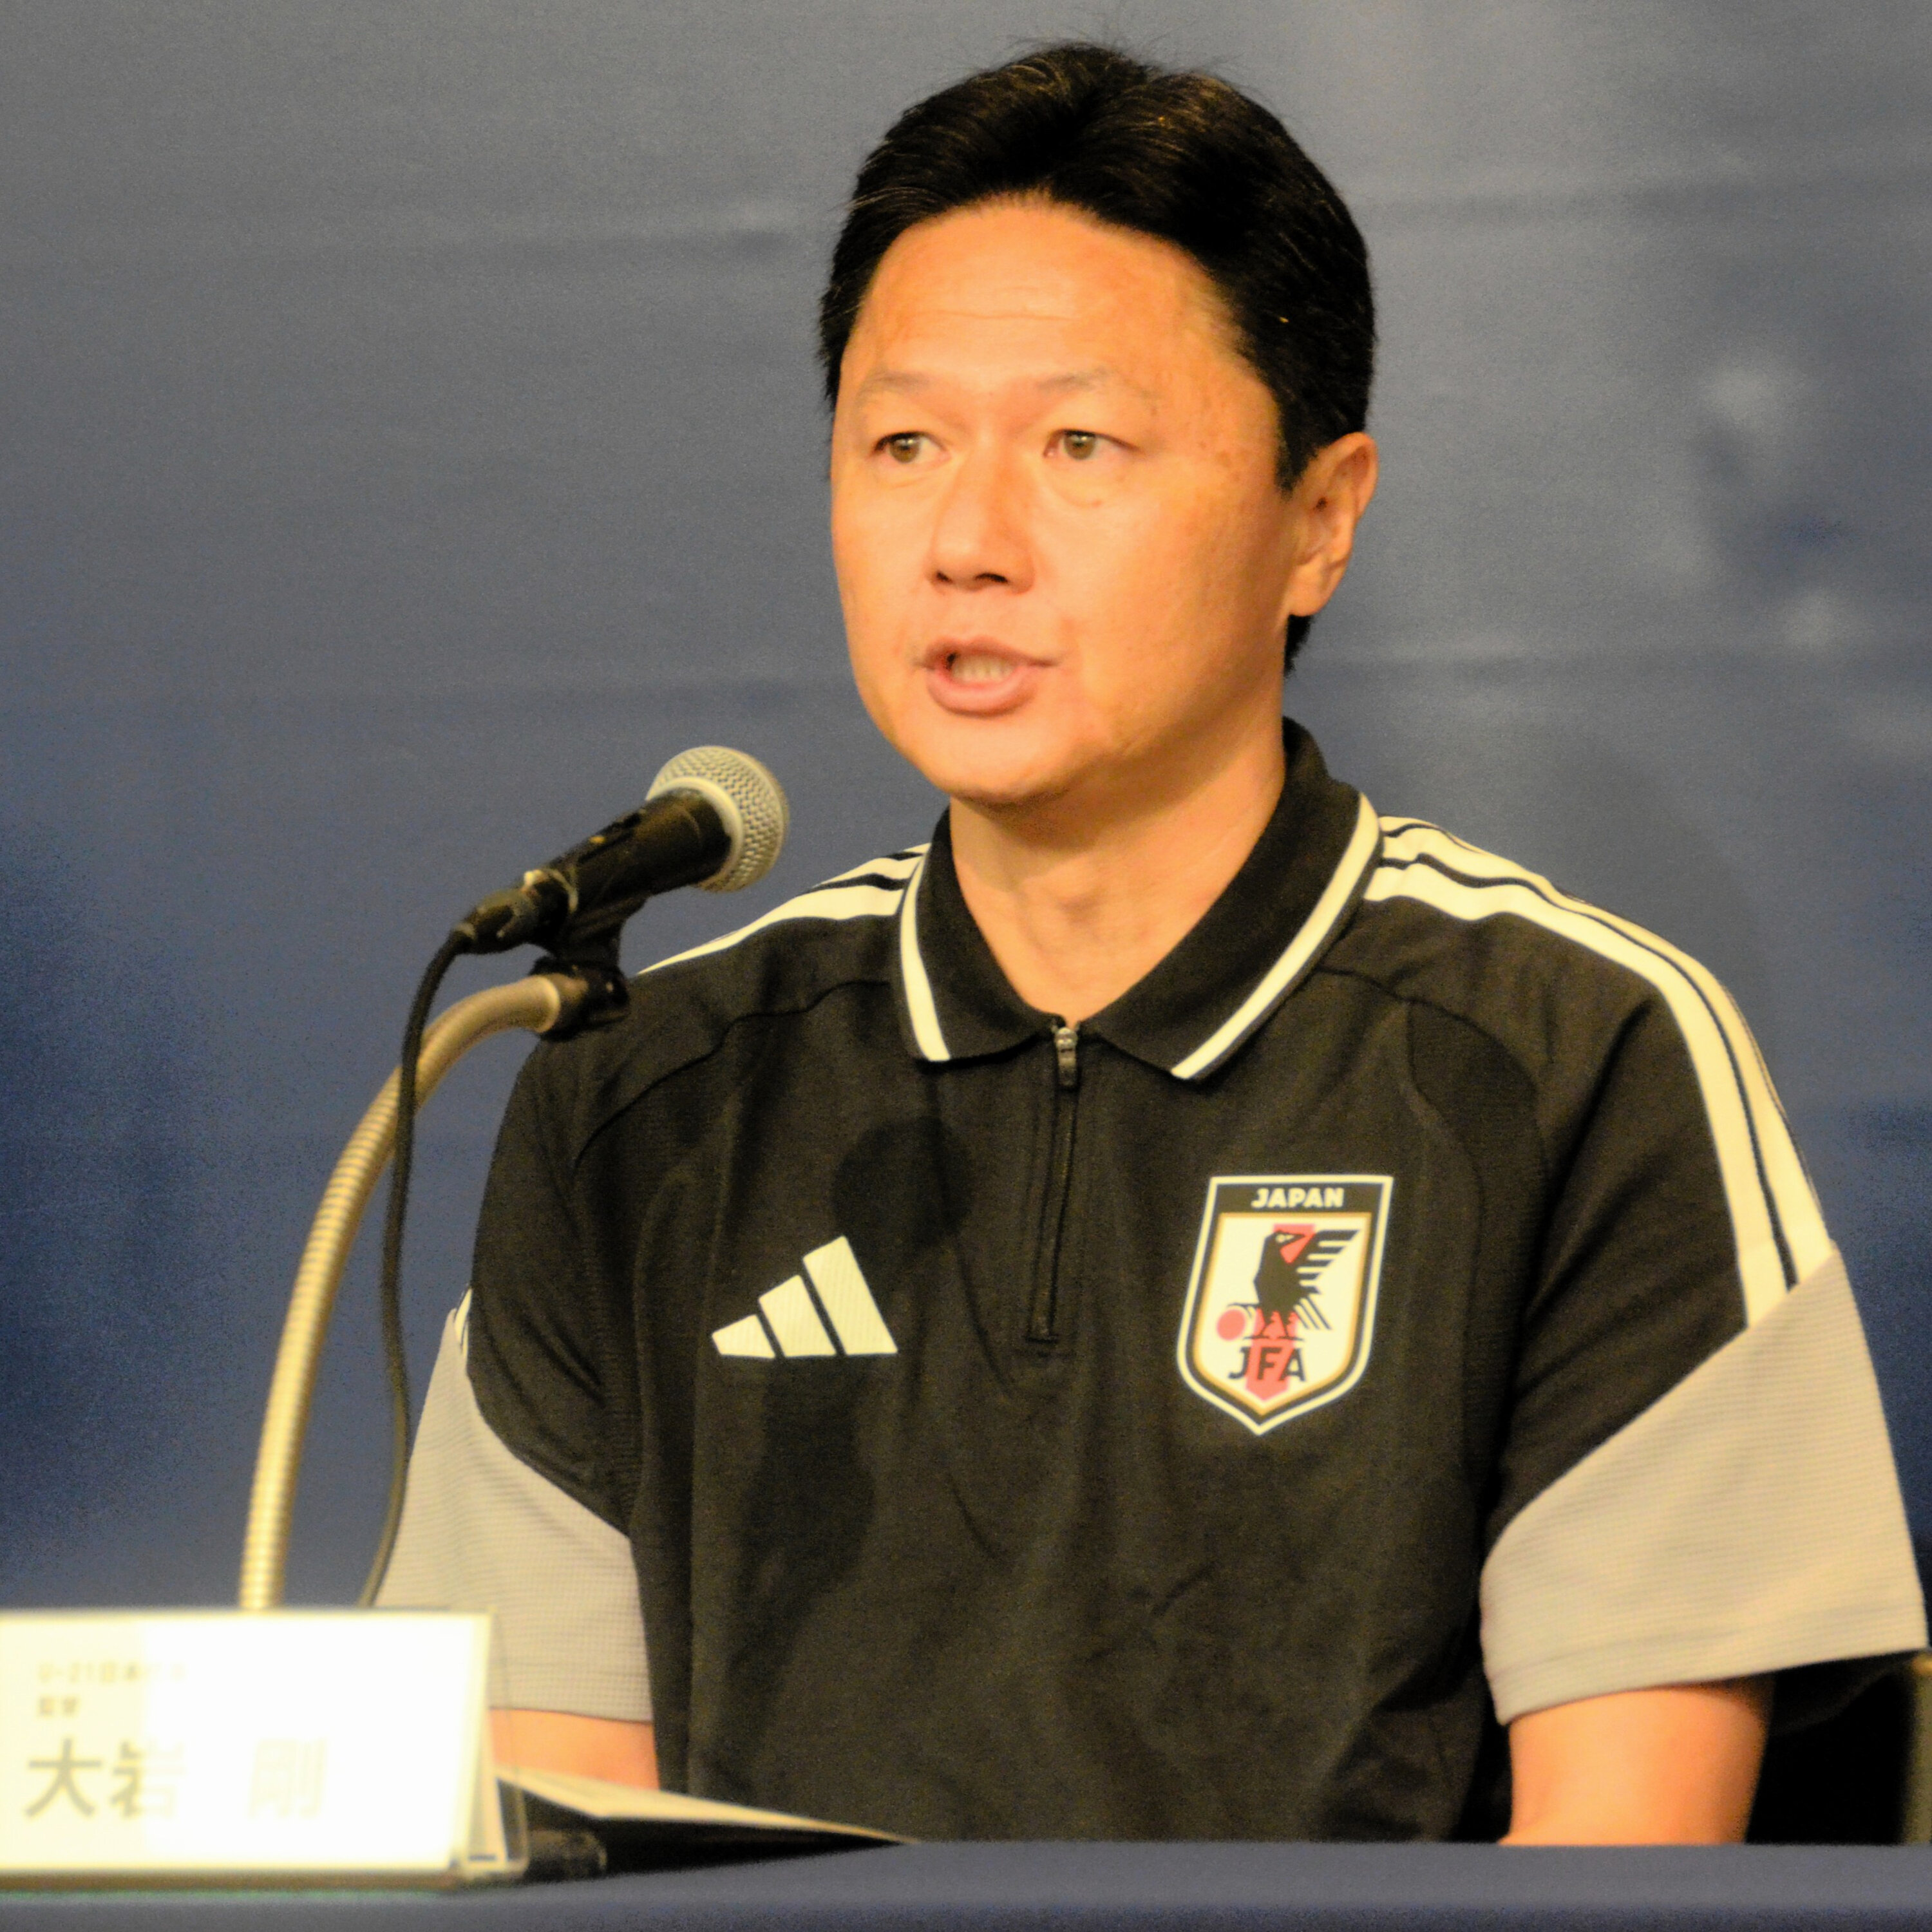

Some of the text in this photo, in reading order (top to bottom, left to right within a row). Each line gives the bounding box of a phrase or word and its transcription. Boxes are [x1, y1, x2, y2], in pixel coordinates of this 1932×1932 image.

[1251, 1188, 1345, 1208] JAPAN
[1228, 1346, 1306, 1382] JFA
[24, 1738, 185, 1819] 大岩
